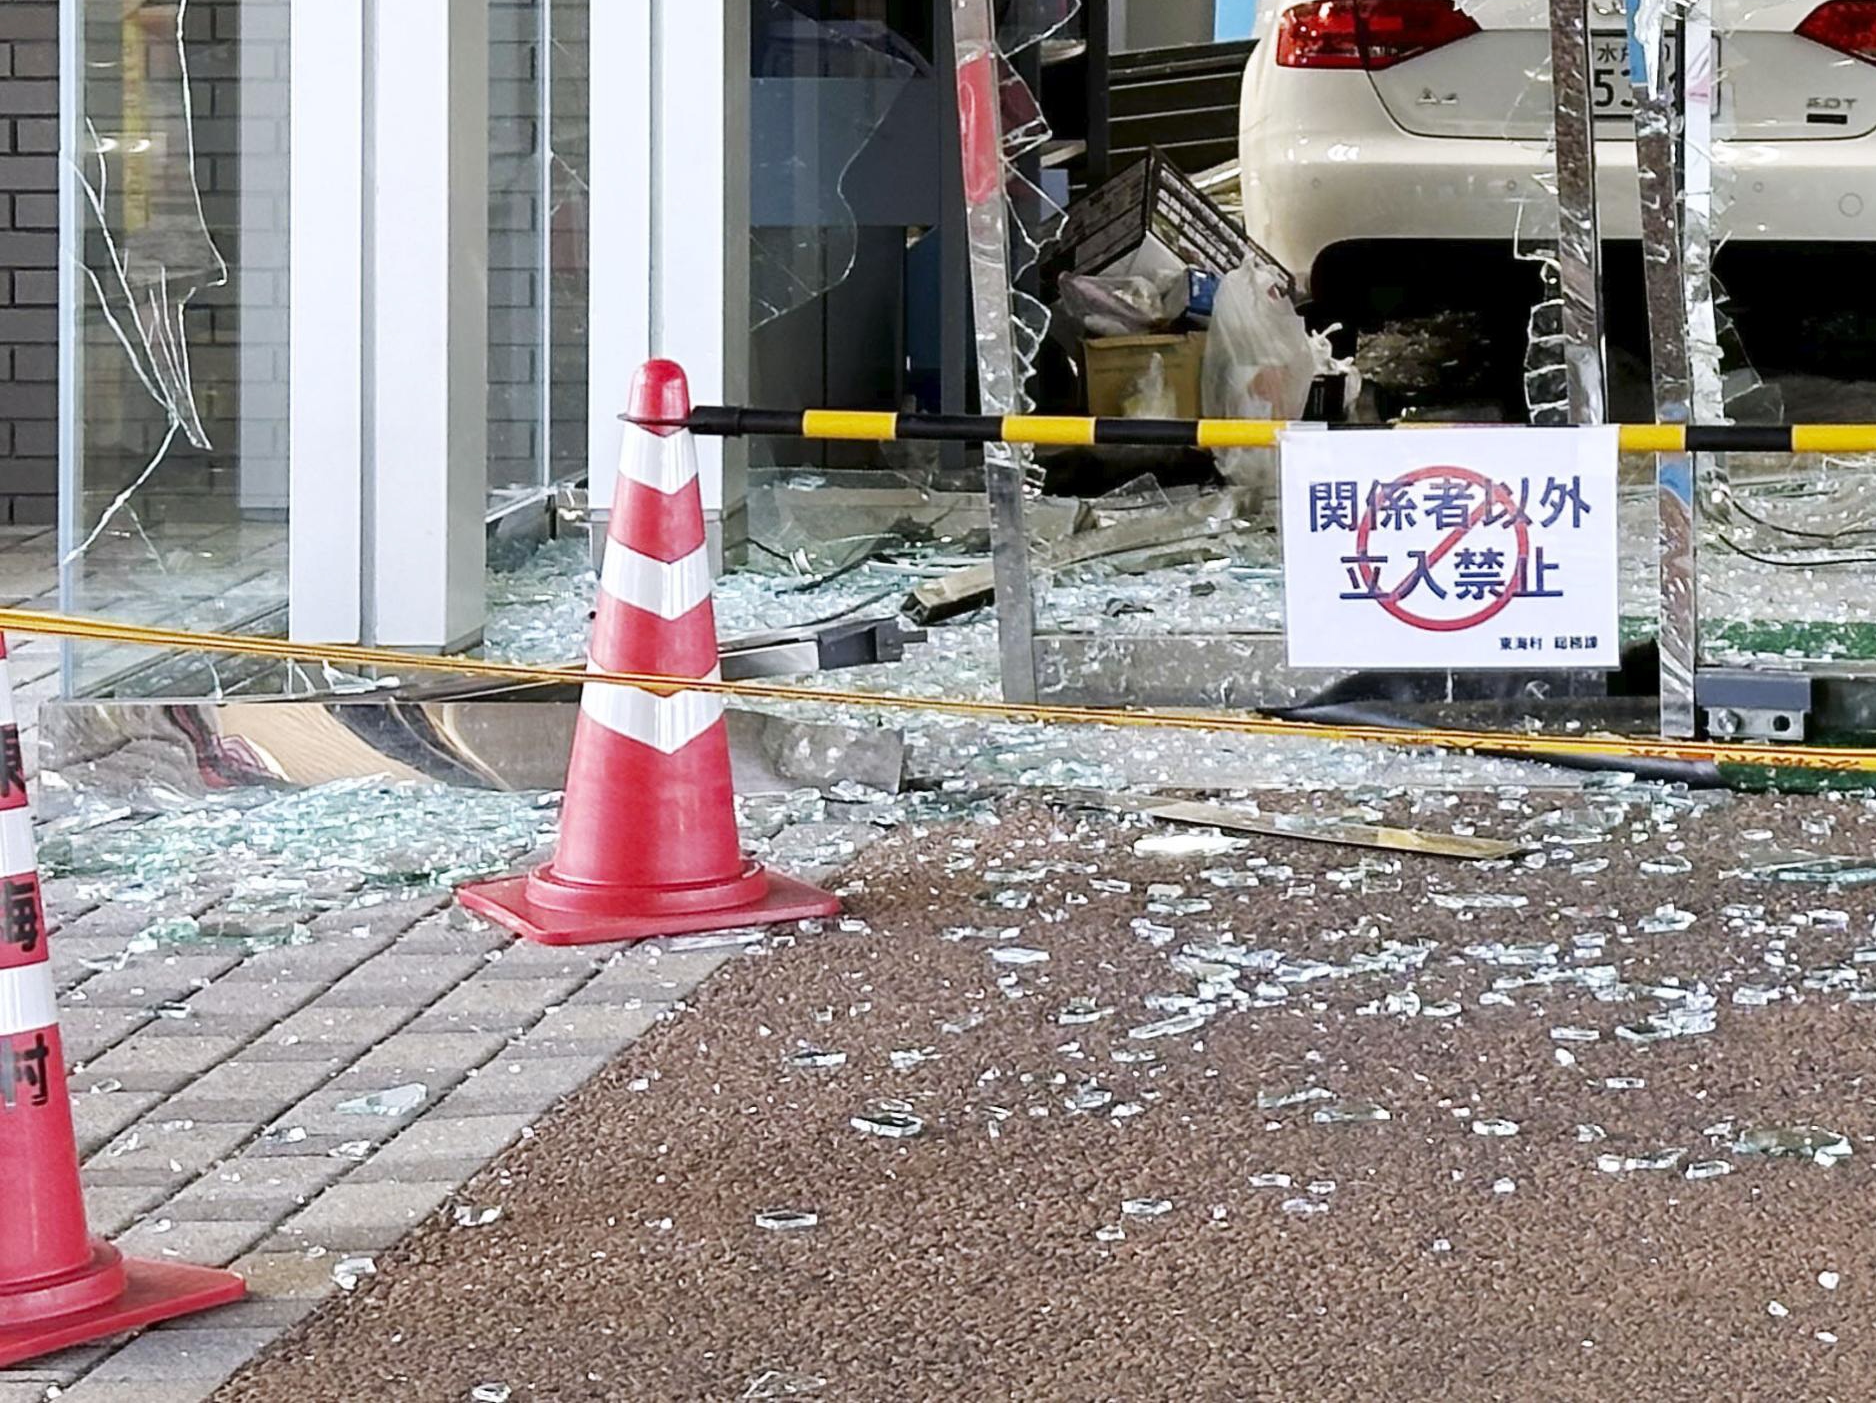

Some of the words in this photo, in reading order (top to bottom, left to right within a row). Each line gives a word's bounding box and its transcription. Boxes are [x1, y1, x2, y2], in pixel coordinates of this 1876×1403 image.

[1308, 475, 1591, 533] 関係者以外
[1340, 547, 1563, 600] 立入禁止
[1500, 637, 1543, 651] 東海村
[1554, 636, 1598, 650] 総務課
